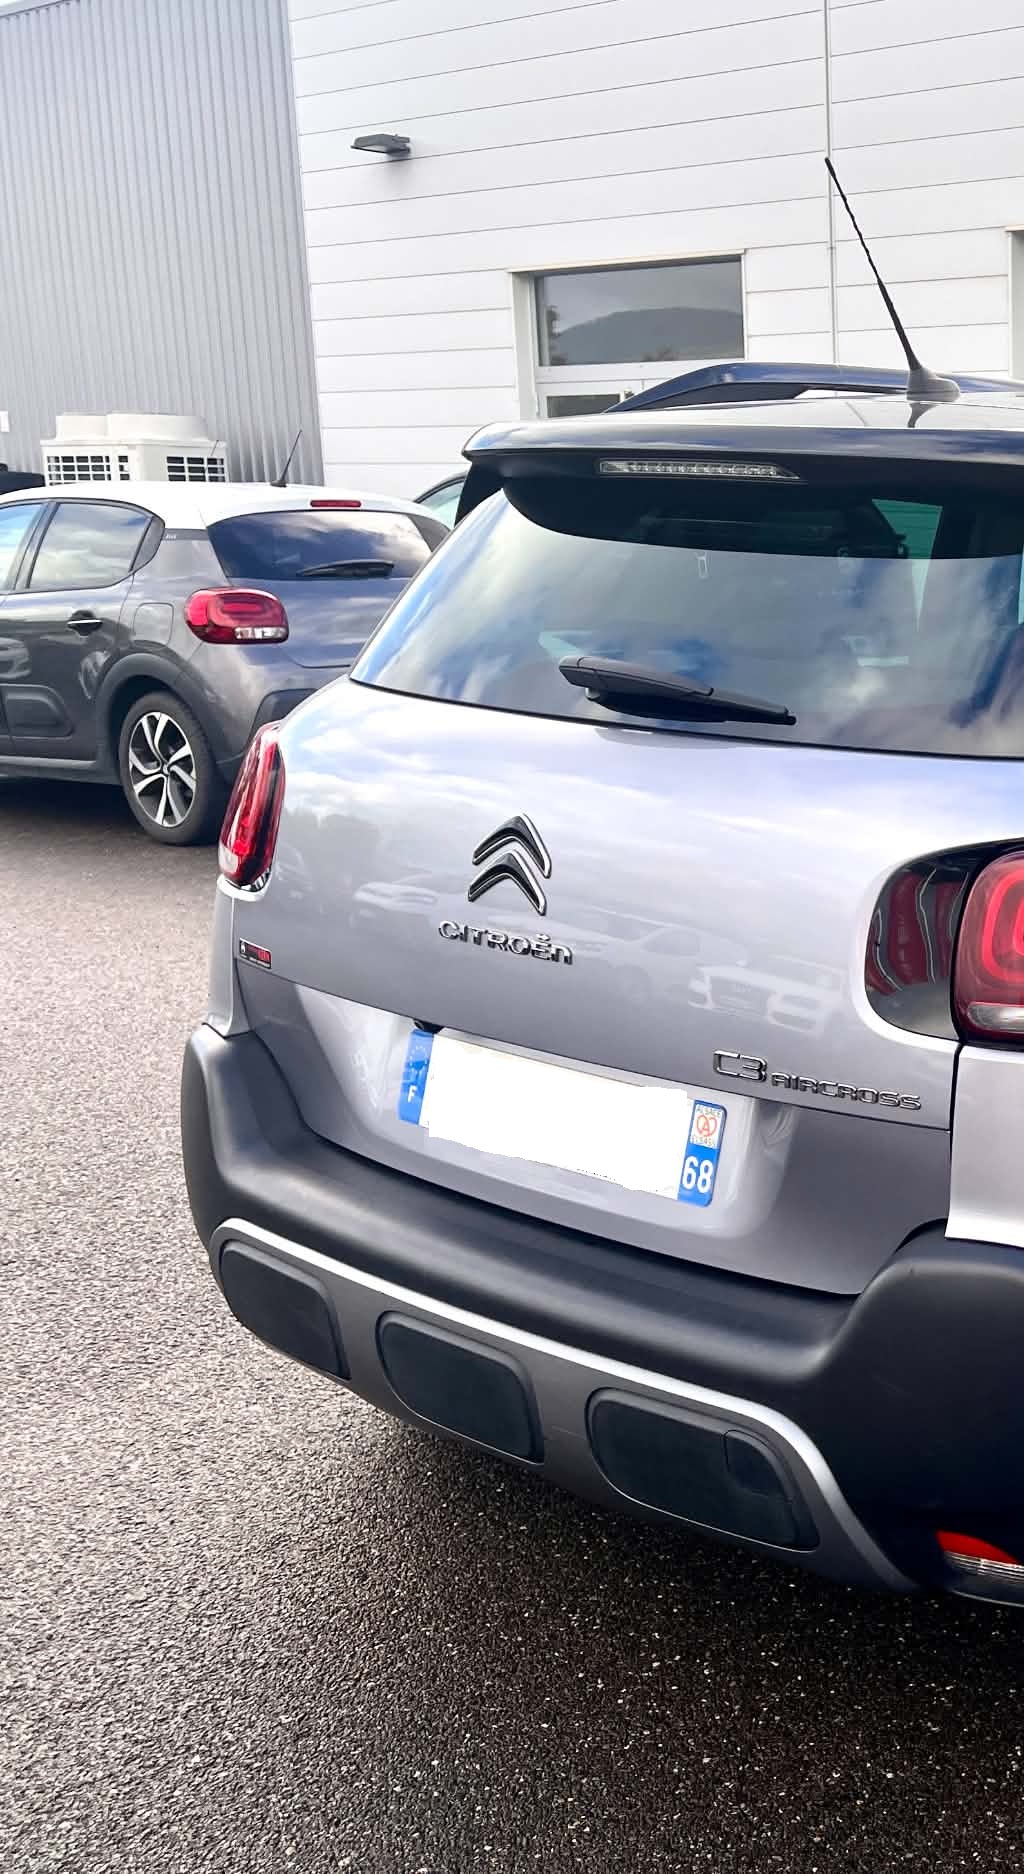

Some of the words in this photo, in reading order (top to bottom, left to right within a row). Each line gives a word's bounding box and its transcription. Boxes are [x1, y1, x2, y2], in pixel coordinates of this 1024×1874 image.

[408, 1085, 418, 1103] F
[712, 1049, 768, 1082] C3
[771, 1072, 922, 1111] AIRCROSS
[682, 1155, 714, 1194] 68
